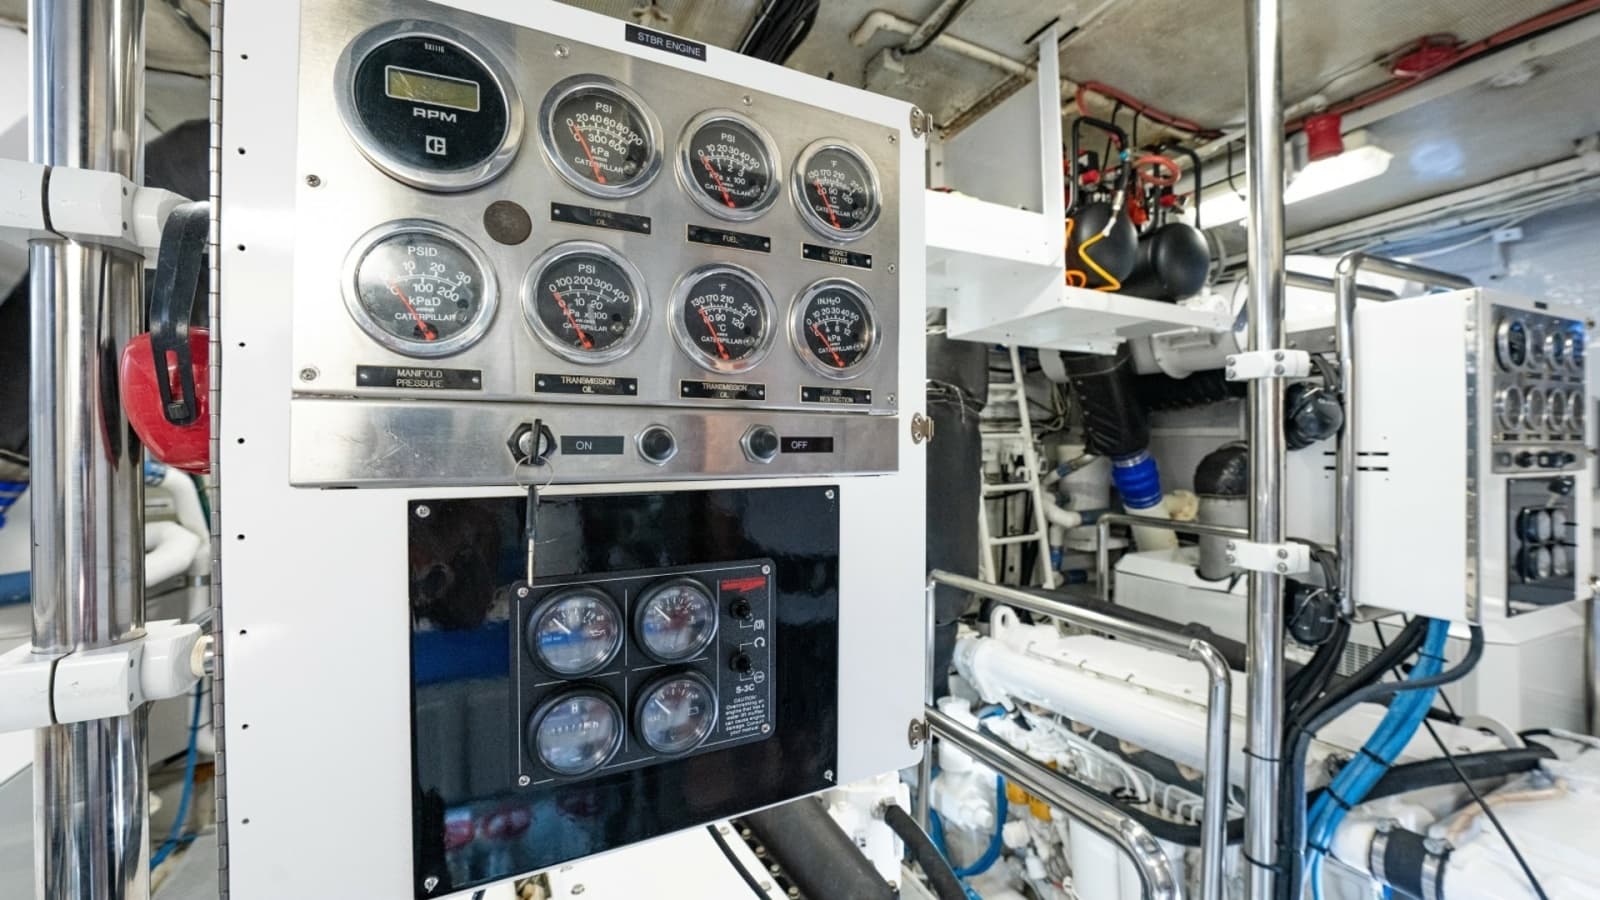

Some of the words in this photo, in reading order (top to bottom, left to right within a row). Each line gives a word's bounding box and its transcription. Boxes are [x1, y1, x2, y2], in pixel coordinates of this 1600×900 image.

[638, 32, 663, 46] STBR
[666, 40, 700, 56] ENGINE
[595, 102, 612, 113] PSI
[413, 107, 457, 123] RPM
[567, 118, 574, 127] 0
[576, 113, 588, 122] 20
[590, 115, 602, 123] 40
[603, 118, 616, 127] 60
[616, 123, 629, 134] 80
[721, 133, 736, 143] PSI
[588, 134, 607, 144] 300
[608, 140, 626, 154] 600
[717, 144, 728, 152] 20
[591, 146, 609, 157] kPa
[722, 234, 738, 244] FUEL
[407, 246, 438, 257] PSID
[402, 260, 415, 271] 10
[430, 262, 445, 273] 20
[456, 272, 471, 284] 30
[578, 264, 595, 274] PSI
[412, 283, 433, 293] 100
[437, 286, 459, 302] 200
[549, 284, 556, 292] 0
[556, 277, 572, 287] 100
[574, 276, 592, 285] 200
[594, 278, 612, 291] 300
[612, 288, 630, 303] 400
[408, 296, 441, 306] kPaD
[575, 298, 585, 306] 10
[591, 300, 603, 310] 20
[691, 296, 705, 307] 130
[720, 295, 734, 303] 210
[395, 312, 456, 321] CATERPILLAR
[821, 307, 830, 315] 20
[732, 318, 744, 329] 120
[397, 369, 442, 378] MANIFOLD
[396, 378, 442, 388] PRESSURE
[560, 375, 616, 385] TRANSMISSION
[702, 382, 748, 391] TRANSMISSION
[576, 441, 592, 450] ON
[791, 440, 808, 449] OFF
[736, 683, 755, 694] S-3C
